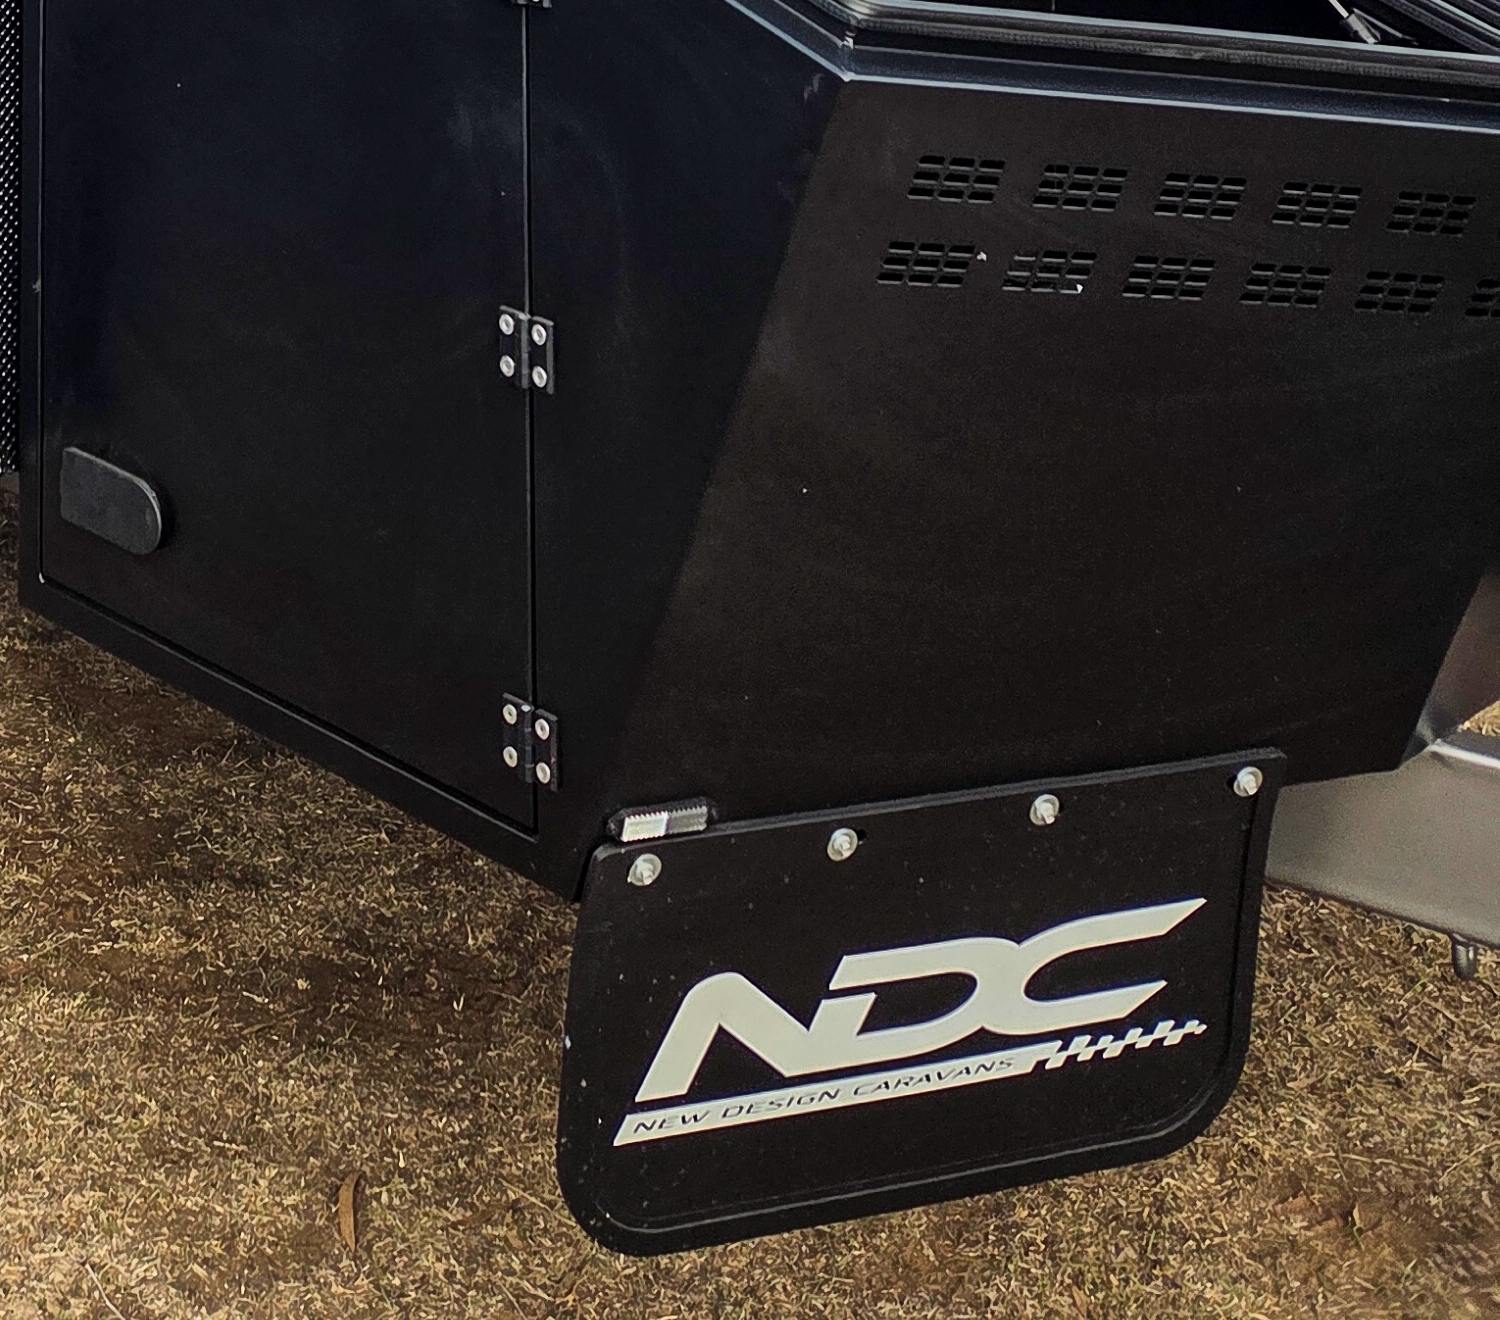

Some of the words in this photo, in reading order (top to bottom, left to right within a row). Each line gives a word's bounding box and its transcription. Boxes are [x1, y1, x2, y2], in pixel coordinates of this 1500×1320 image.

[634, 898, 1206, 1103] NDC
[632, 1109, 711, 1135] NEW
[721, 1086, 841, 1120] DESIGN
[852, 1058, 1015, 1097] CARAVANS
